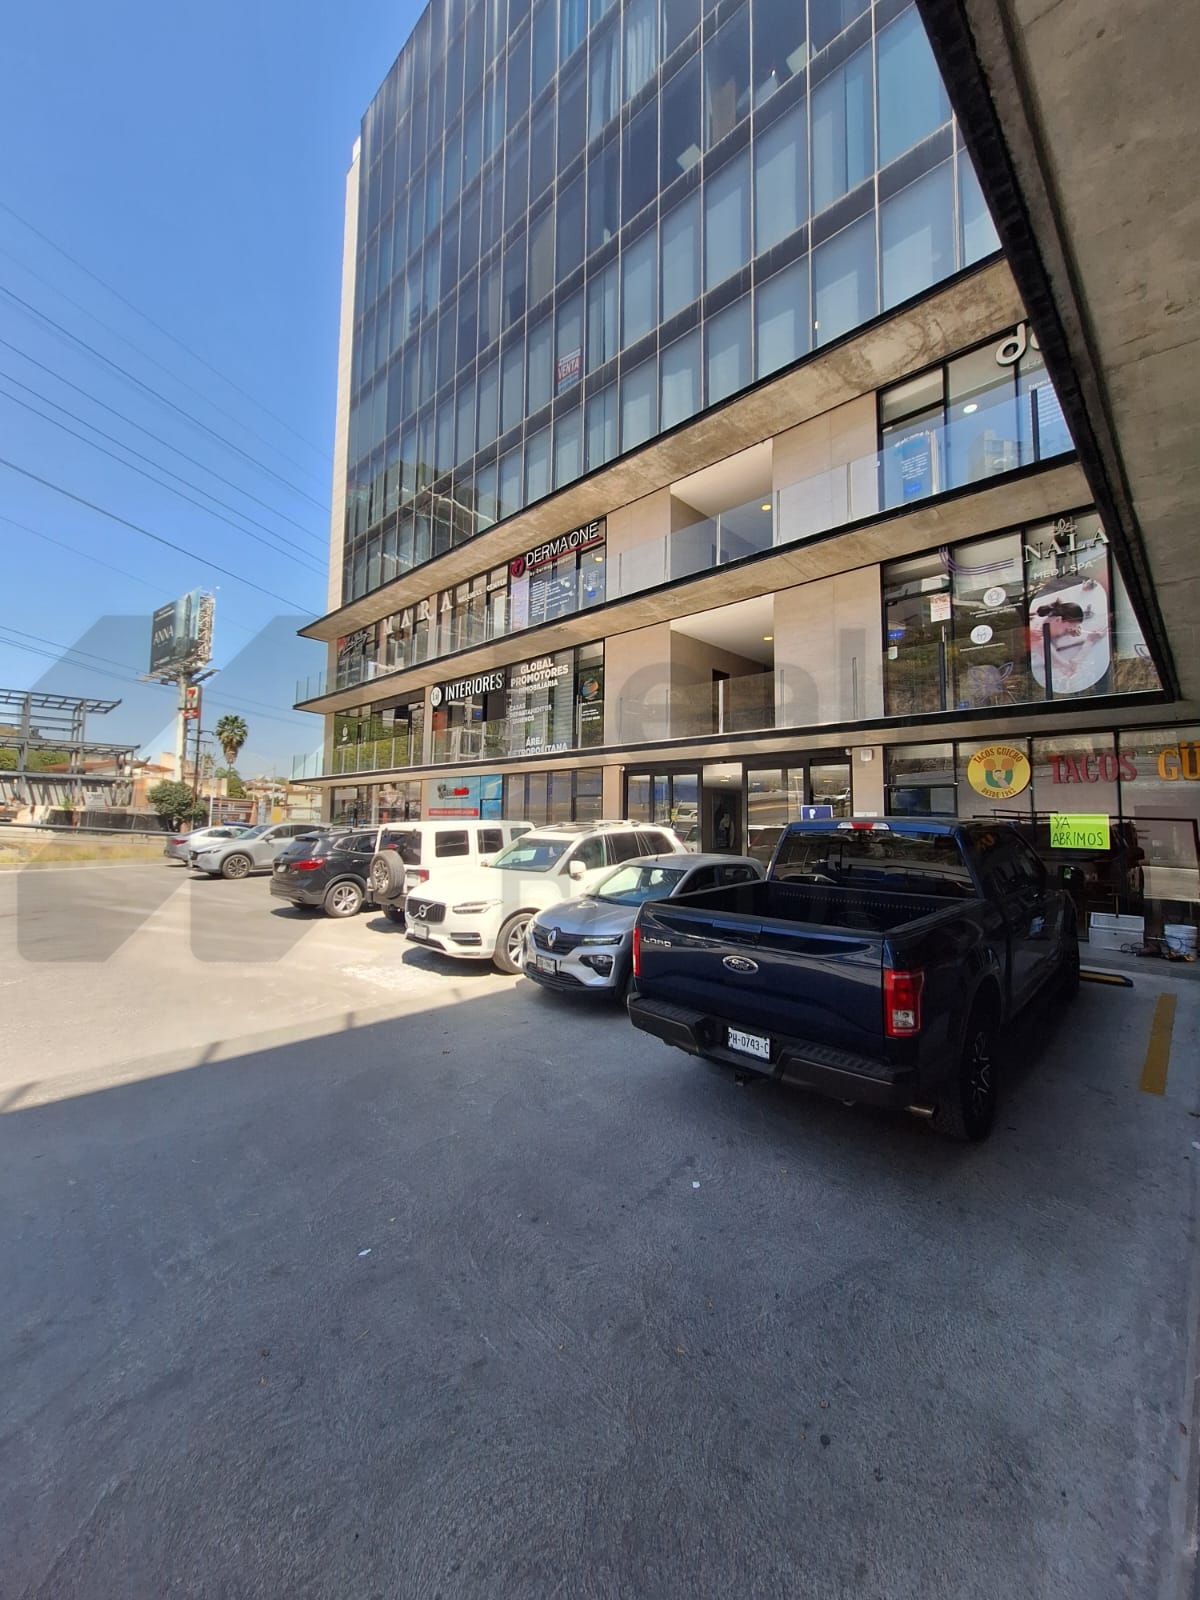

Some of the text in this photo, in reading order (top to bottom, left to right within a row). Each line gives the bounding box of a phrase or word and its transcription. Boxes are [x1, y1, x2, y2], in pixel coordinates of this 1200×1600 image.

[1024, 528, 1109, 562] NALA
[510, 664, 569, 687] PROMOTORES
[520, 657, 554, 675] GLOBAL
[445, 672, 504, 701] INTERIORES
[973, 747, 1024, 764] TACOS GUICHO
[1046, 751, 1138, 784] TACOS
[1053, 816, 1071, 829] YA
[1052, 832, 1104, 846] ABRIMOS
